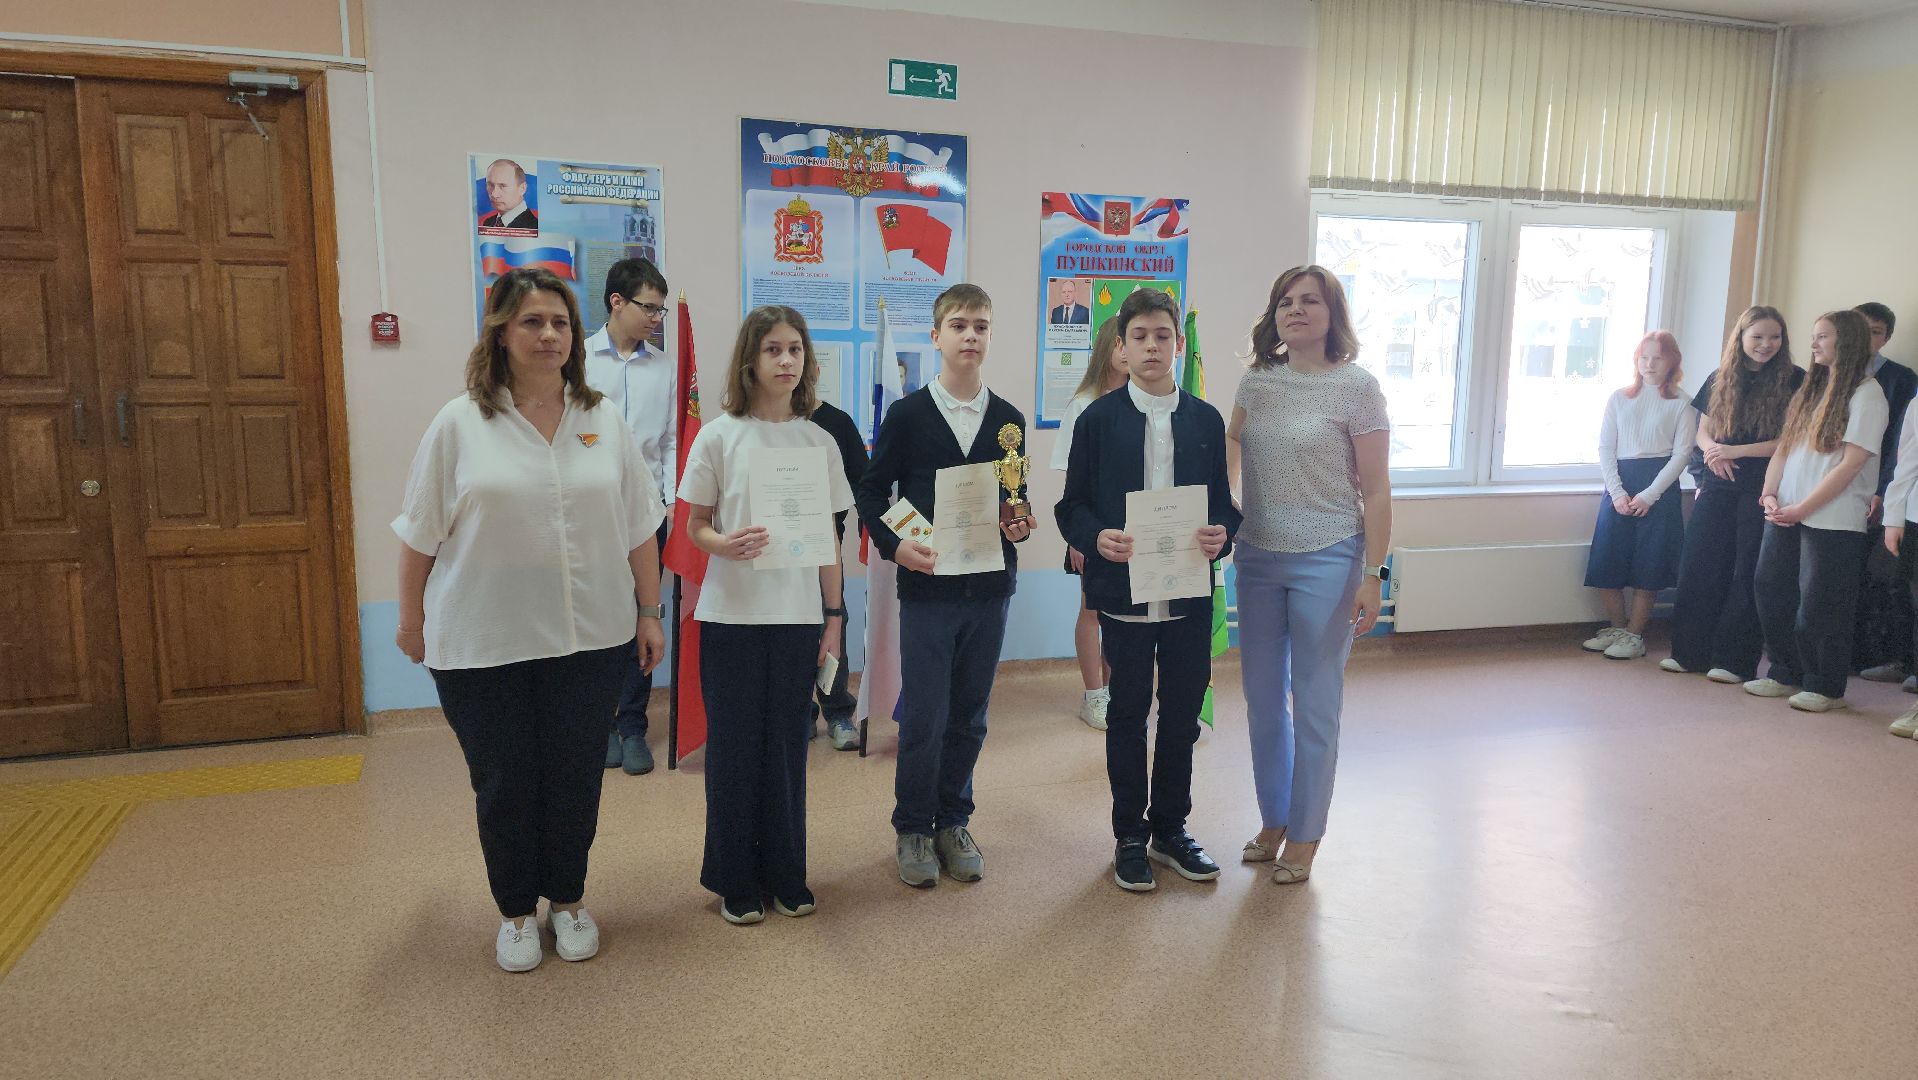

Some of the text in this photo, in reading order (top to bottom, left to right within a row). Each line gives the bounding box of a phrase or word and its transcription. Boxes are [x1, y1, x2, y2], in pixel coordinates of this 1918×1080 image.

[870, 161, 900, 173] КРАЙ
[620, 176, 645, 187] ГИМН
[547, 184, 660, 200] РОССИЙСКОЙ ФЕДЕРАЦИИ
[1065, 242, 1165, 255] ГОРОДСКОЙ ОКРУГ
[1056, 255, 1174, 273] ПУШКИНСКИЙ
